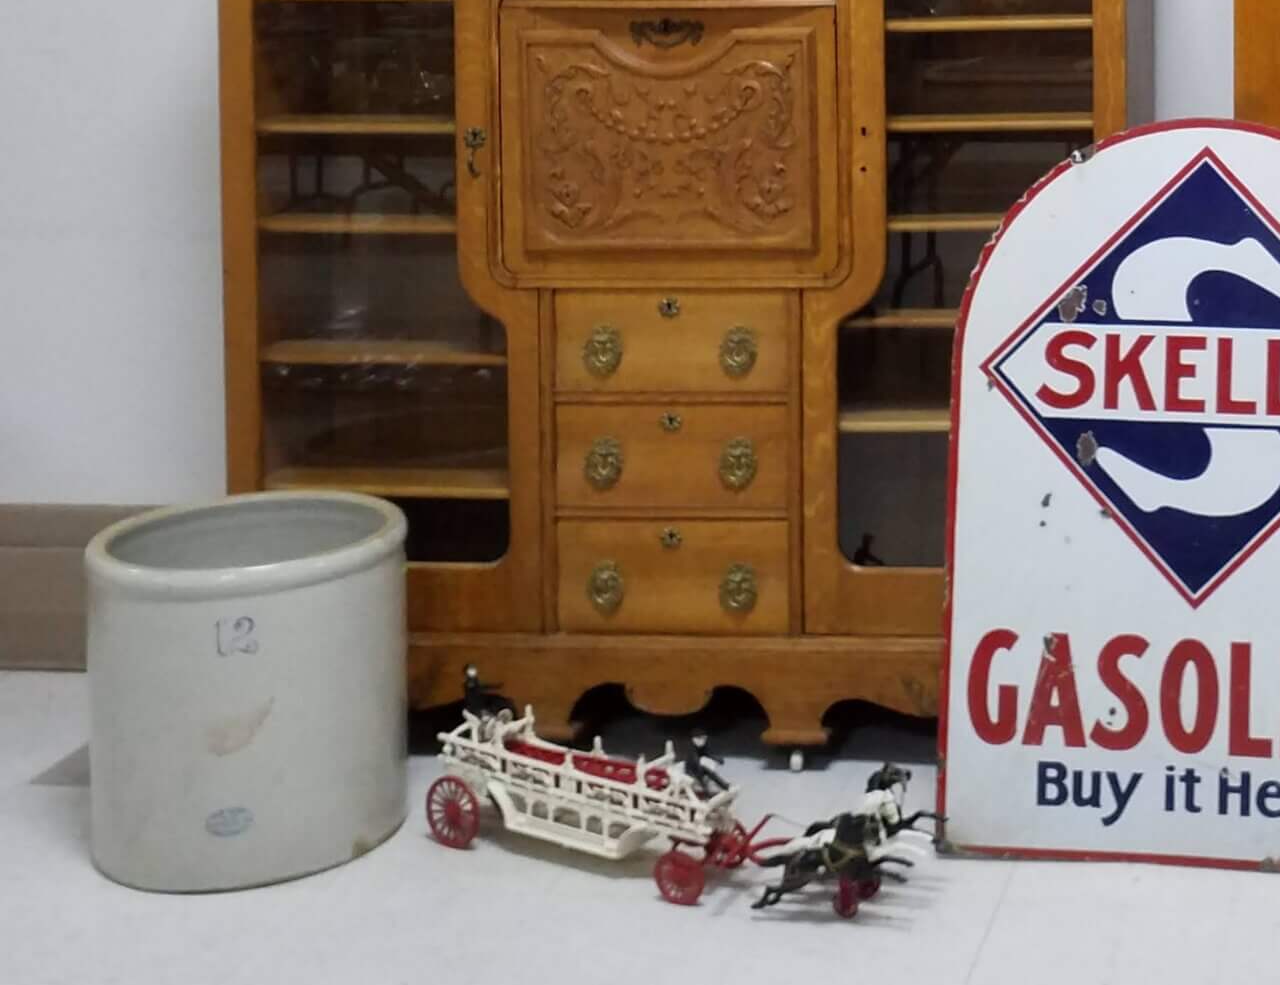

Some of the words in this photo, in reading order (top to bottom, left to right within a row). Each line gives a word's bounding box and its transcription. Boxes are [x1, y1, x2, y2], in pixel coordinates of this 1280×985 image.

[214, 615, 259, 657] 12
[1036, 759, 1143, 826] Buy
[1164, 764, 1202, 813] it
